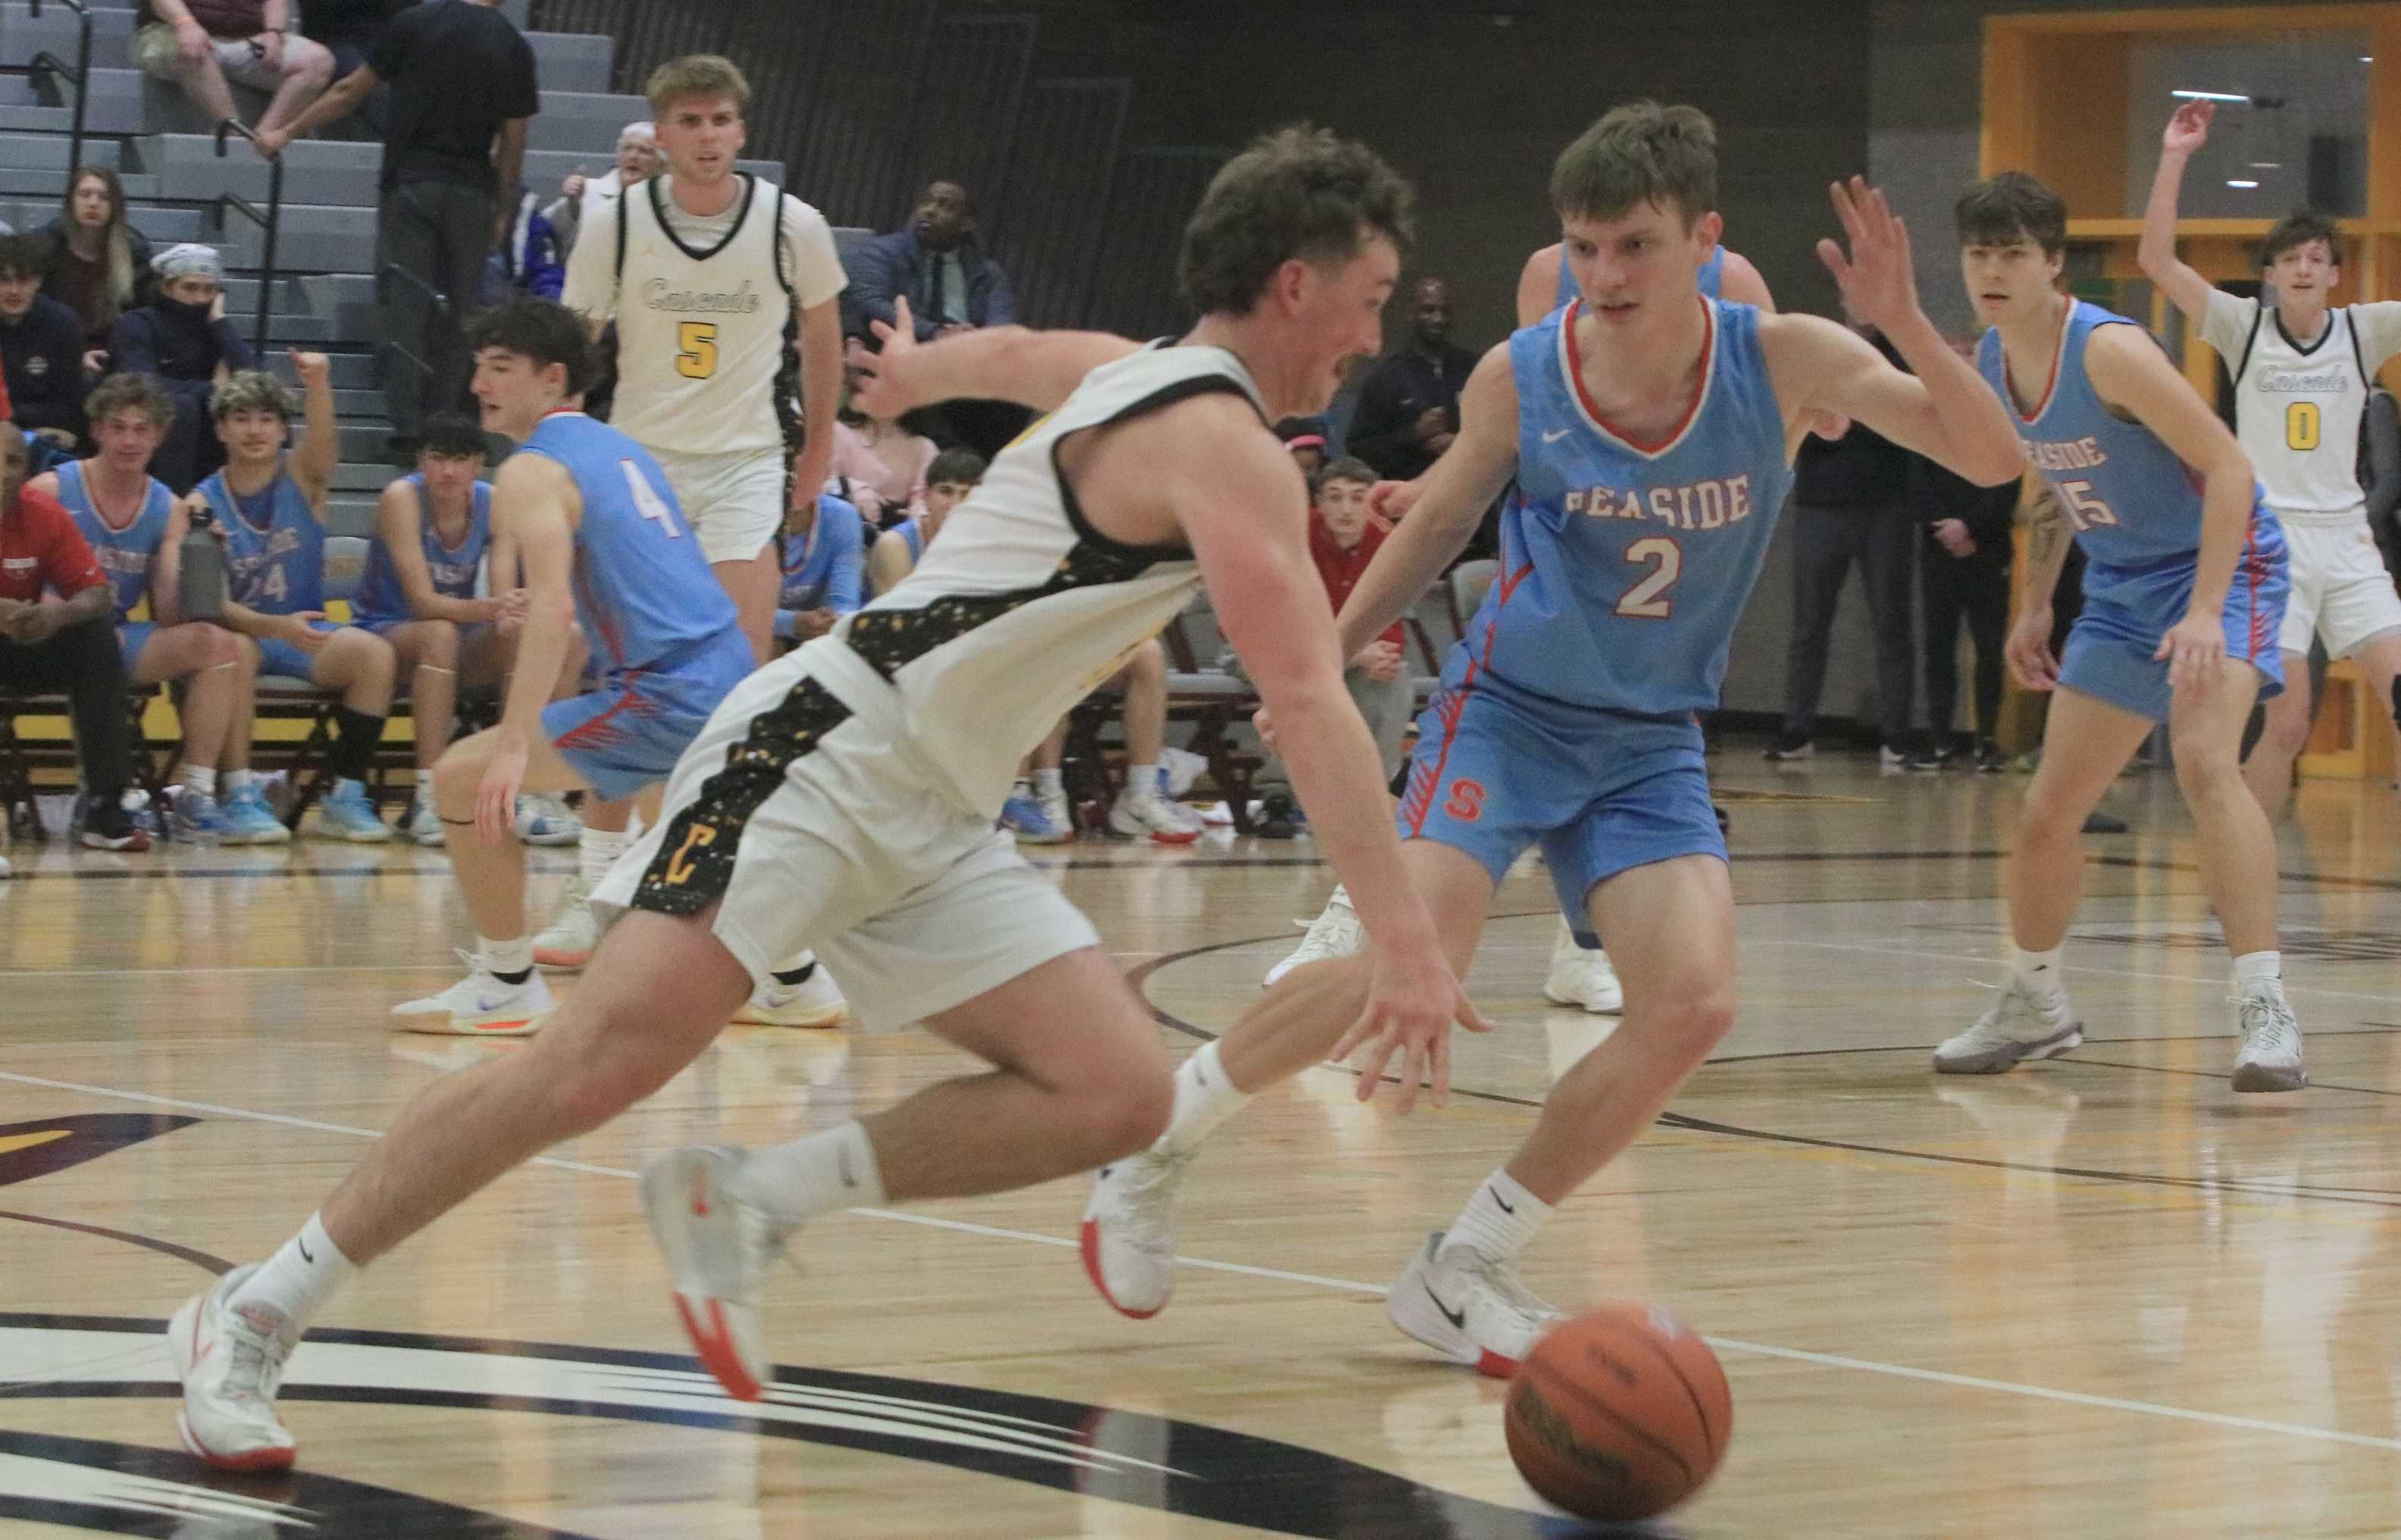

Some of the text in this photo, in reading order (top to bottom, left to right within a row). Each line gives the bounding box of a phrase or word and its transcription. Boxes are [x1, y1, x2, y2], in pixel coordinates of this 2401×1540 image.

[641, 277, 760, 314] Cascade
[676, 321, 718, 379] 5
[2286, 402, 2321, 451] 0
[619, 457, 681, 539] 4
[1613, 535, 1682, 620] 2
[1442, 776, 1487, 822] S
[665, 823, 717, 885] C
